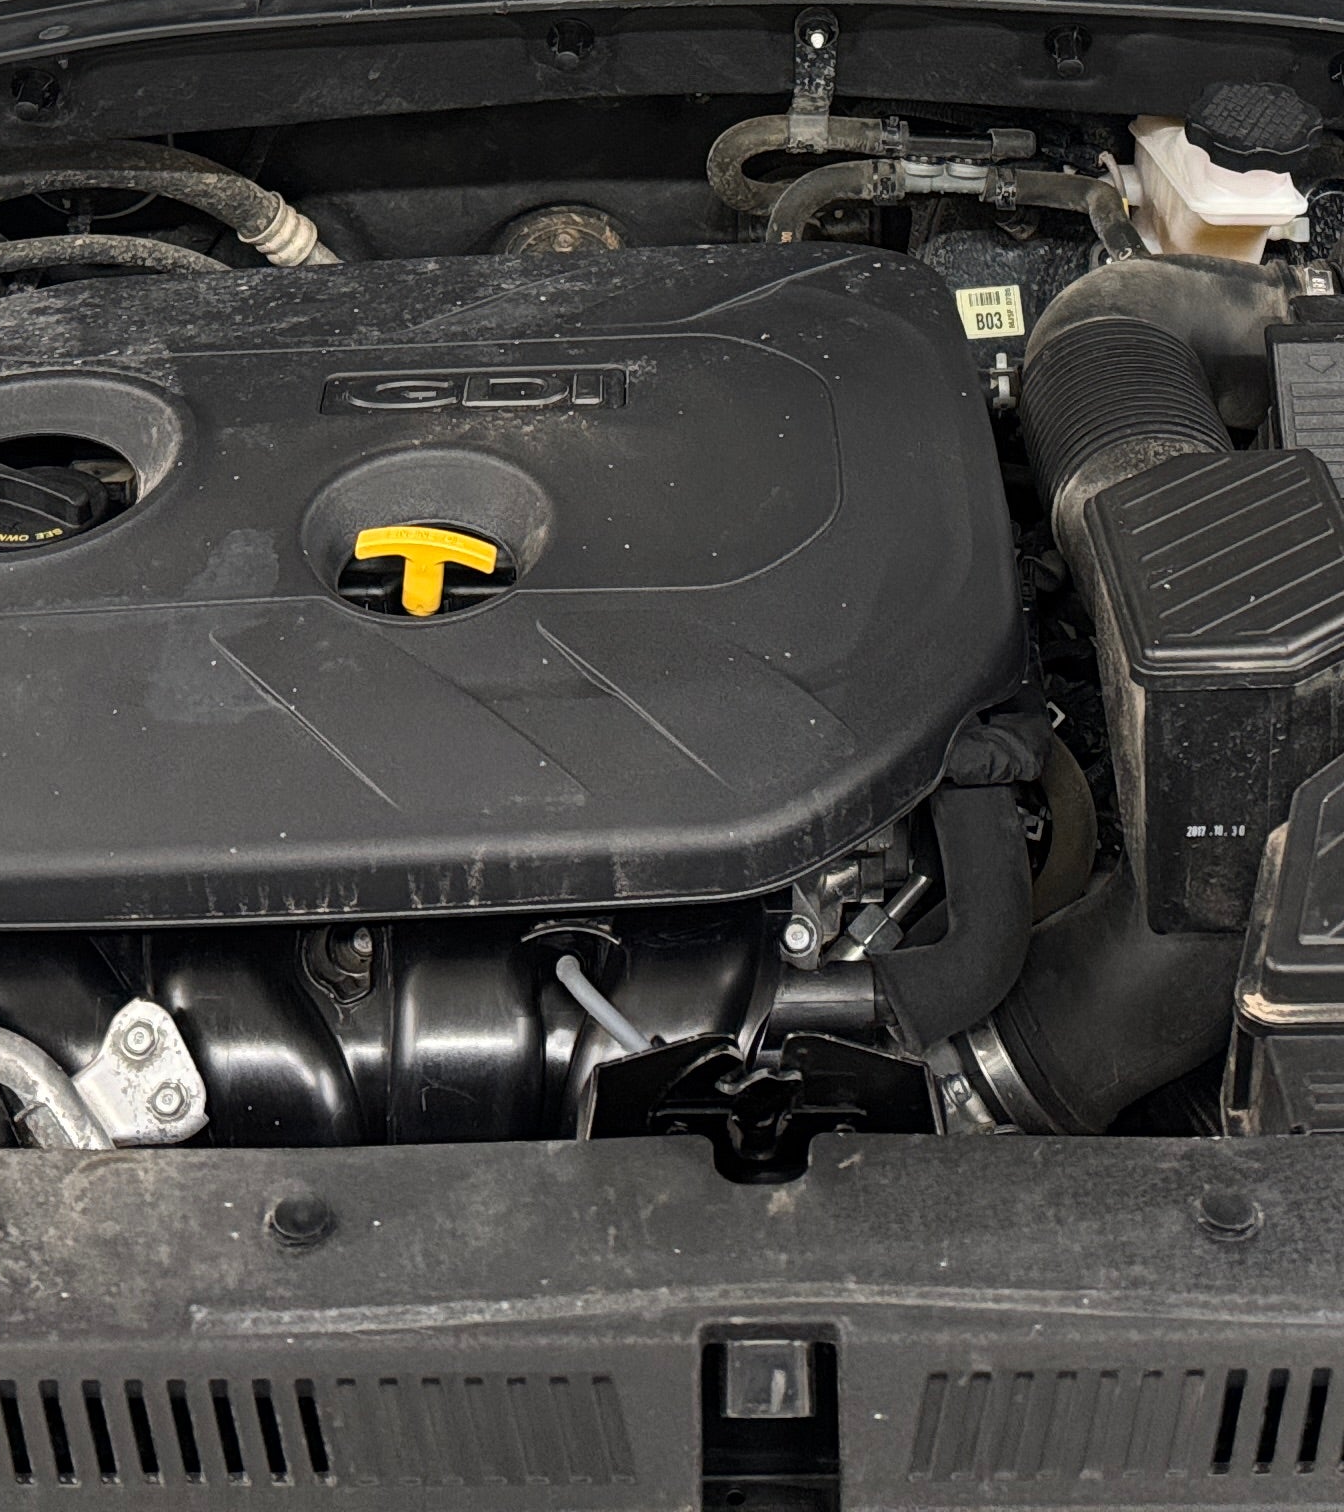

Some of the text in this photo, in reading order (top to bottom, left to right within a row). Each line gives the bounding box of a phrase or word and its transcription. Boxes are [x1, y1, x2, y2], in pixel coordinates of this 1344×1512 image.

[976, 311, 1004, 331] B03
[343, 372, 604, 410] GDI
[35, 528, 64, 541] SEE
